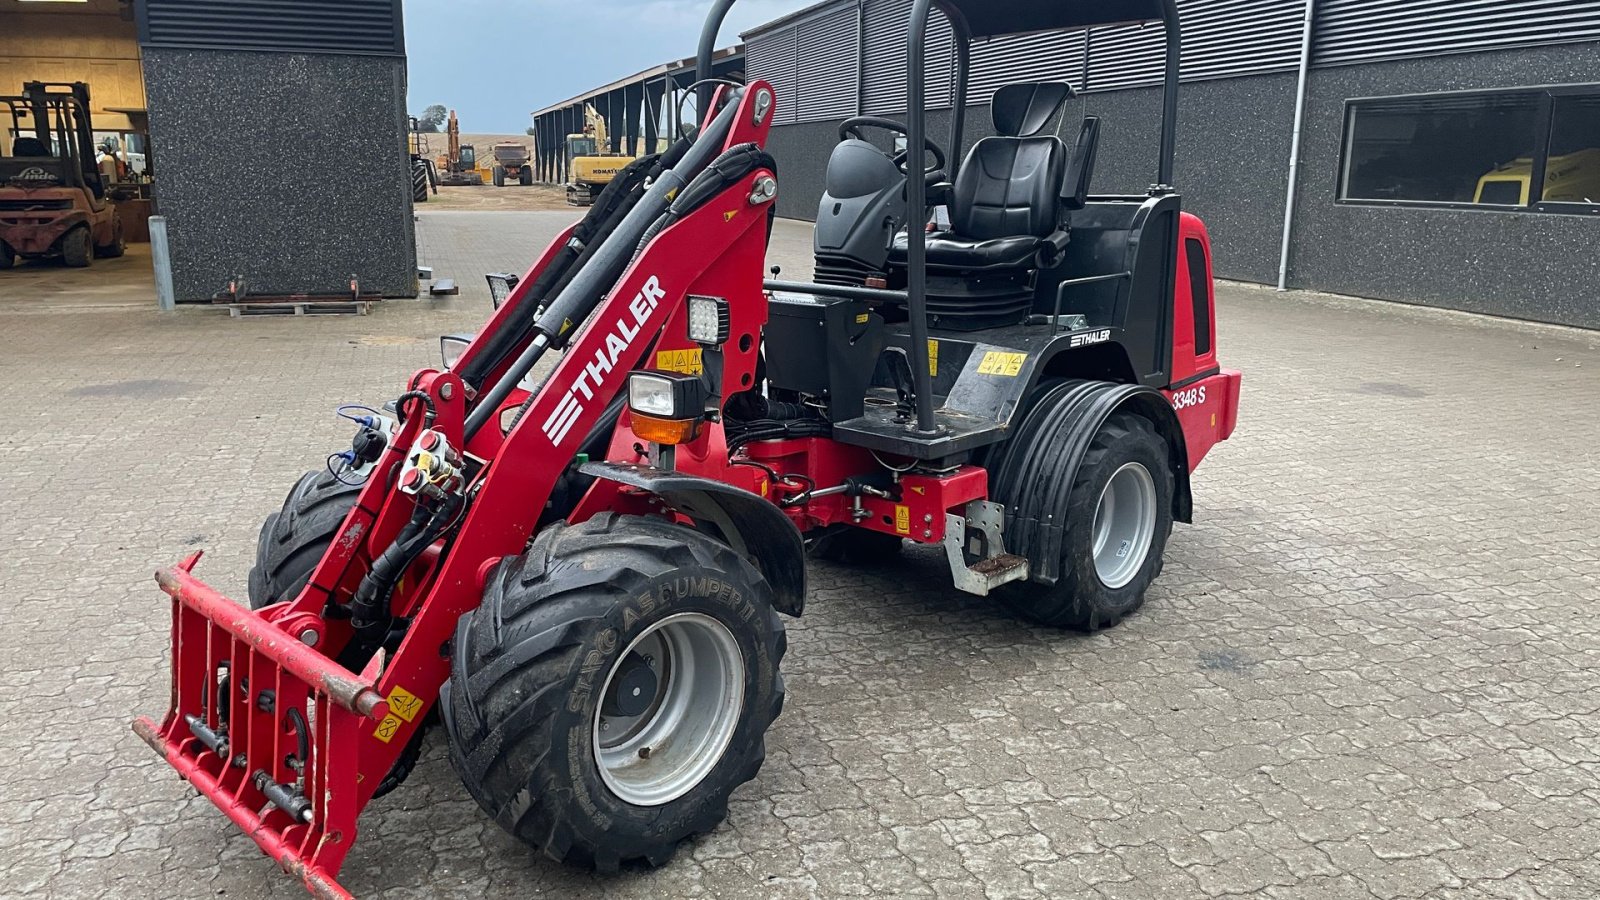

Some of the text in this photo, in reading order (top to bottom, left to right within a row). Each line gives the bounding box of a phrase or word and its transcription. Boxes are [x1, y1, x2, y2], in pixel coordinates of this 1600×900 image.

[9, 166, 58, 181] Linde
[570, 275, 666, 401] THALER
[1080, 329, 1111, 345] THALER
[1172, 385, 1206, 411] 3348 S
[659, 576, 743, 608] DUMPER
